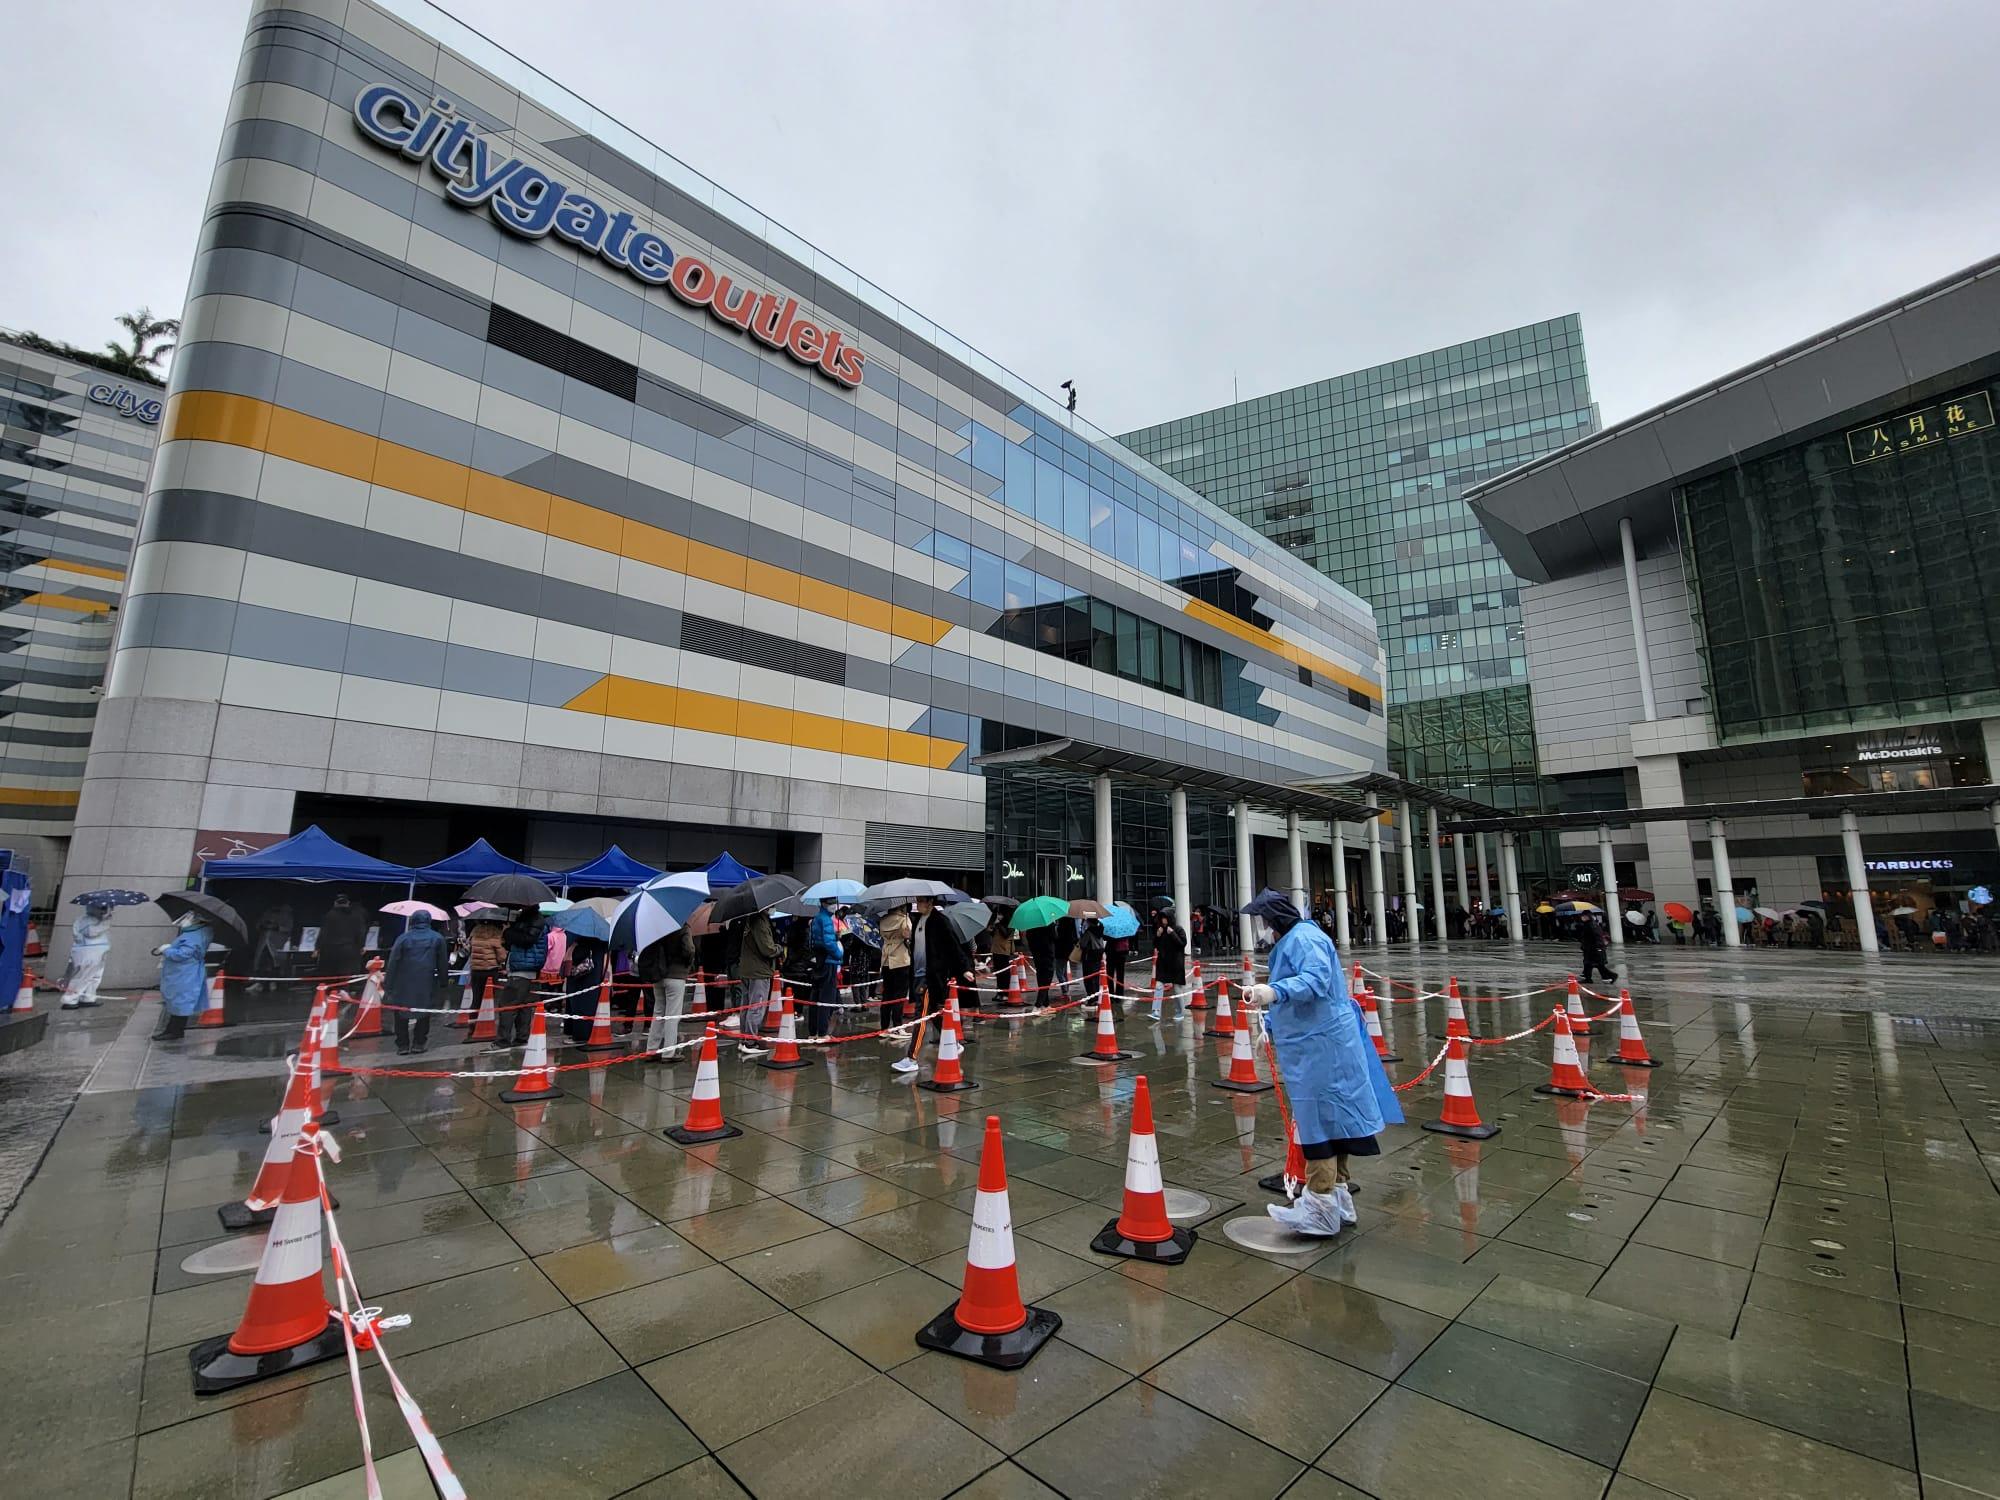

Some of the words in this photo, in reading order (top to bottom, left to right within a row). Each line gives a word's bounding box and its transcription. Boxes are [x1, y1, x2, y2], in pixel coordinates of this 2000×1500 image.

[1872, 404, 1965, 446] 八月花
[1868, 420, 1978, 457] JASMINE
[1858, 746, 1942, 760] McDonald's
[1864, 859, 1954, 870] TARBUCKS
